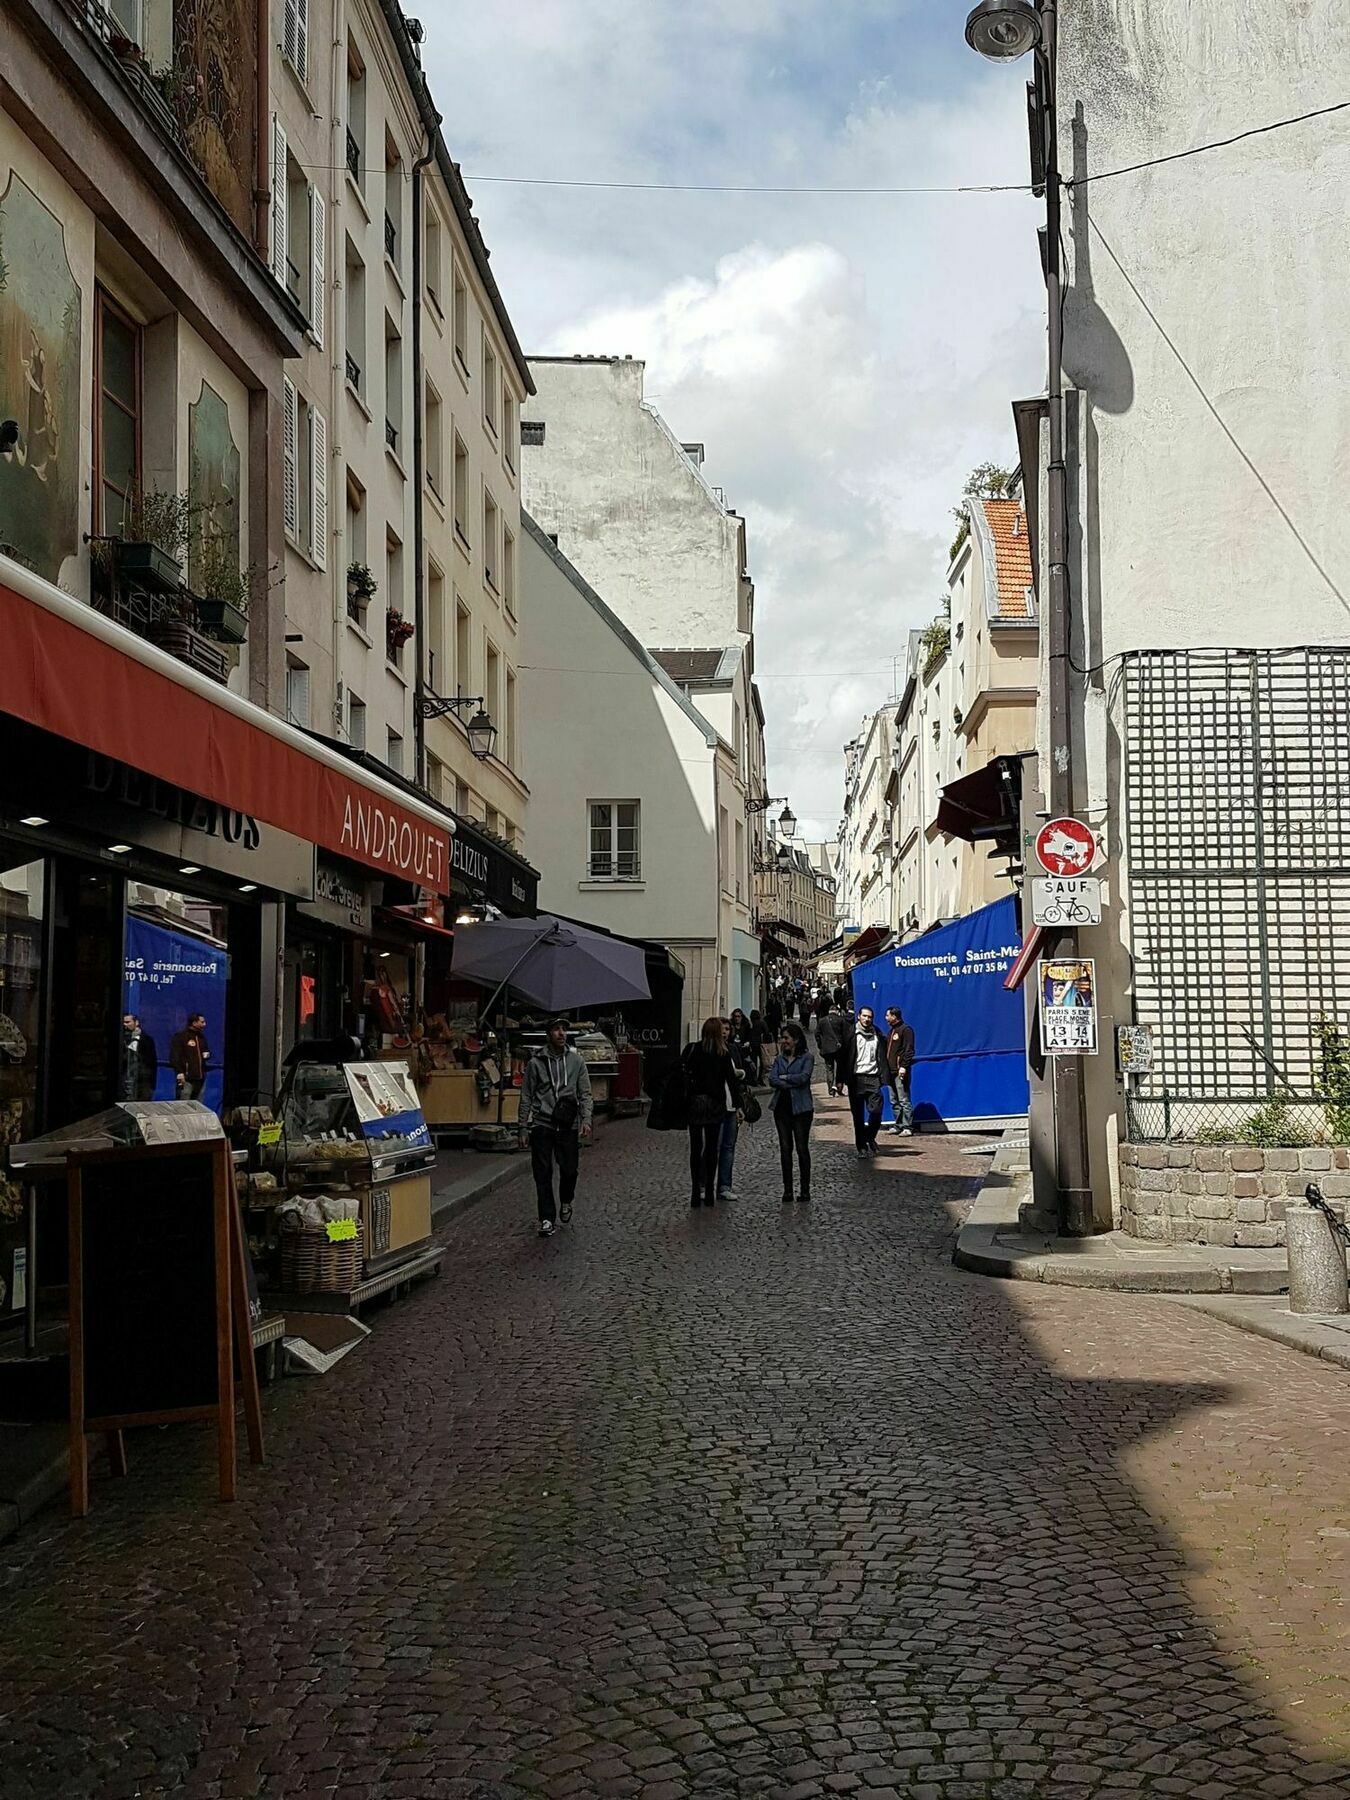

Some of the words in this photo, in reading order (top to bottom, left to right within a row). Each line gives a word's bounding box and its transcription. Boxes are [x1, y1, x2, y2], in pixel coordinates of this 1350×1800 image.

[340, 794, 444, 883] ANDROUET
[1045, 881, 1087, 893] SAUF
[895, 952, 957, 967] Poissonnerie
[934, 967, 949, 977] Tel.
[951, 966, 960, 976] 01
[961, 965, 971, 975] 47
[973, 964, 984, 973] 07
[985, 963, 995, 972] 35
[997, 961, 1008, 971] 84
[1051, 1026, 1066, 1035] 13
[1075, 1026, 1087, 1035] 14
